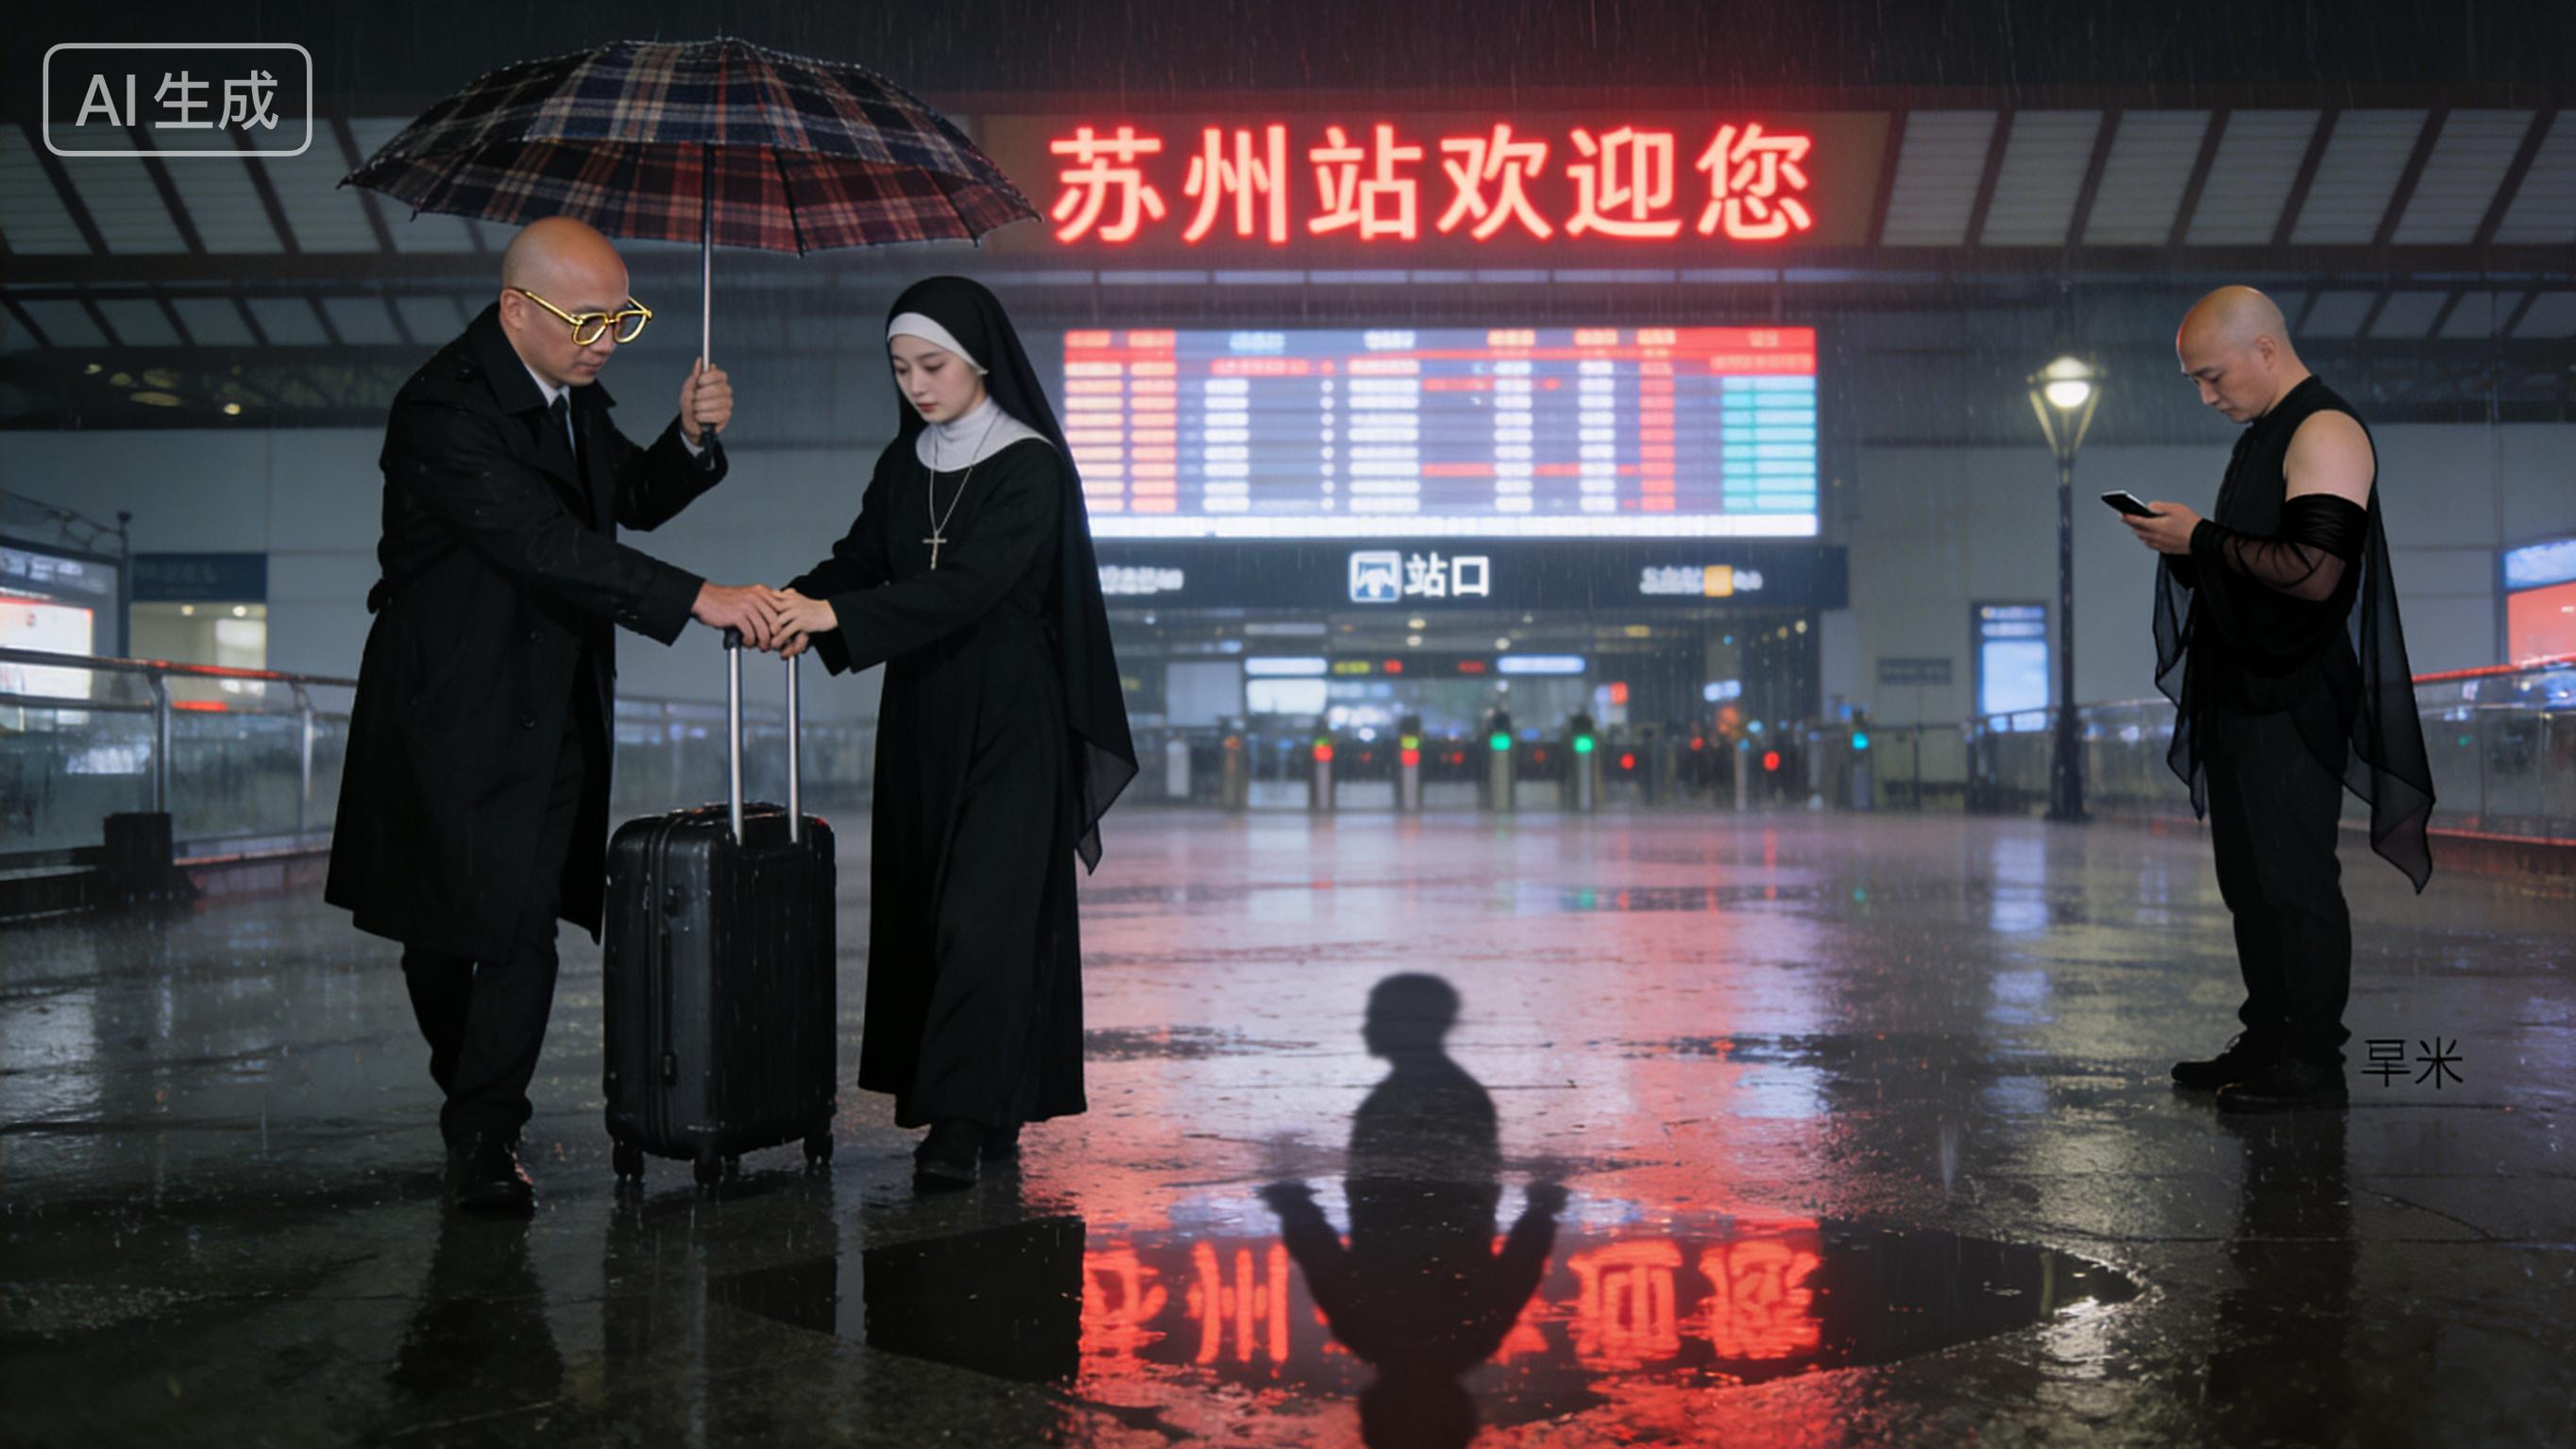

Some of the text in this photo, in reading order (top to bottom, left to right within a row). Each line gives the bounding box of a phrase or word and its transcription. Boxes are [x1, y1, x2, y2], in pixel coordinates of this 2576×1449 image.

[1049, 123, 1814, 244] 苏州站欢迎您
[1404, 550, 1490, 598] 站口
